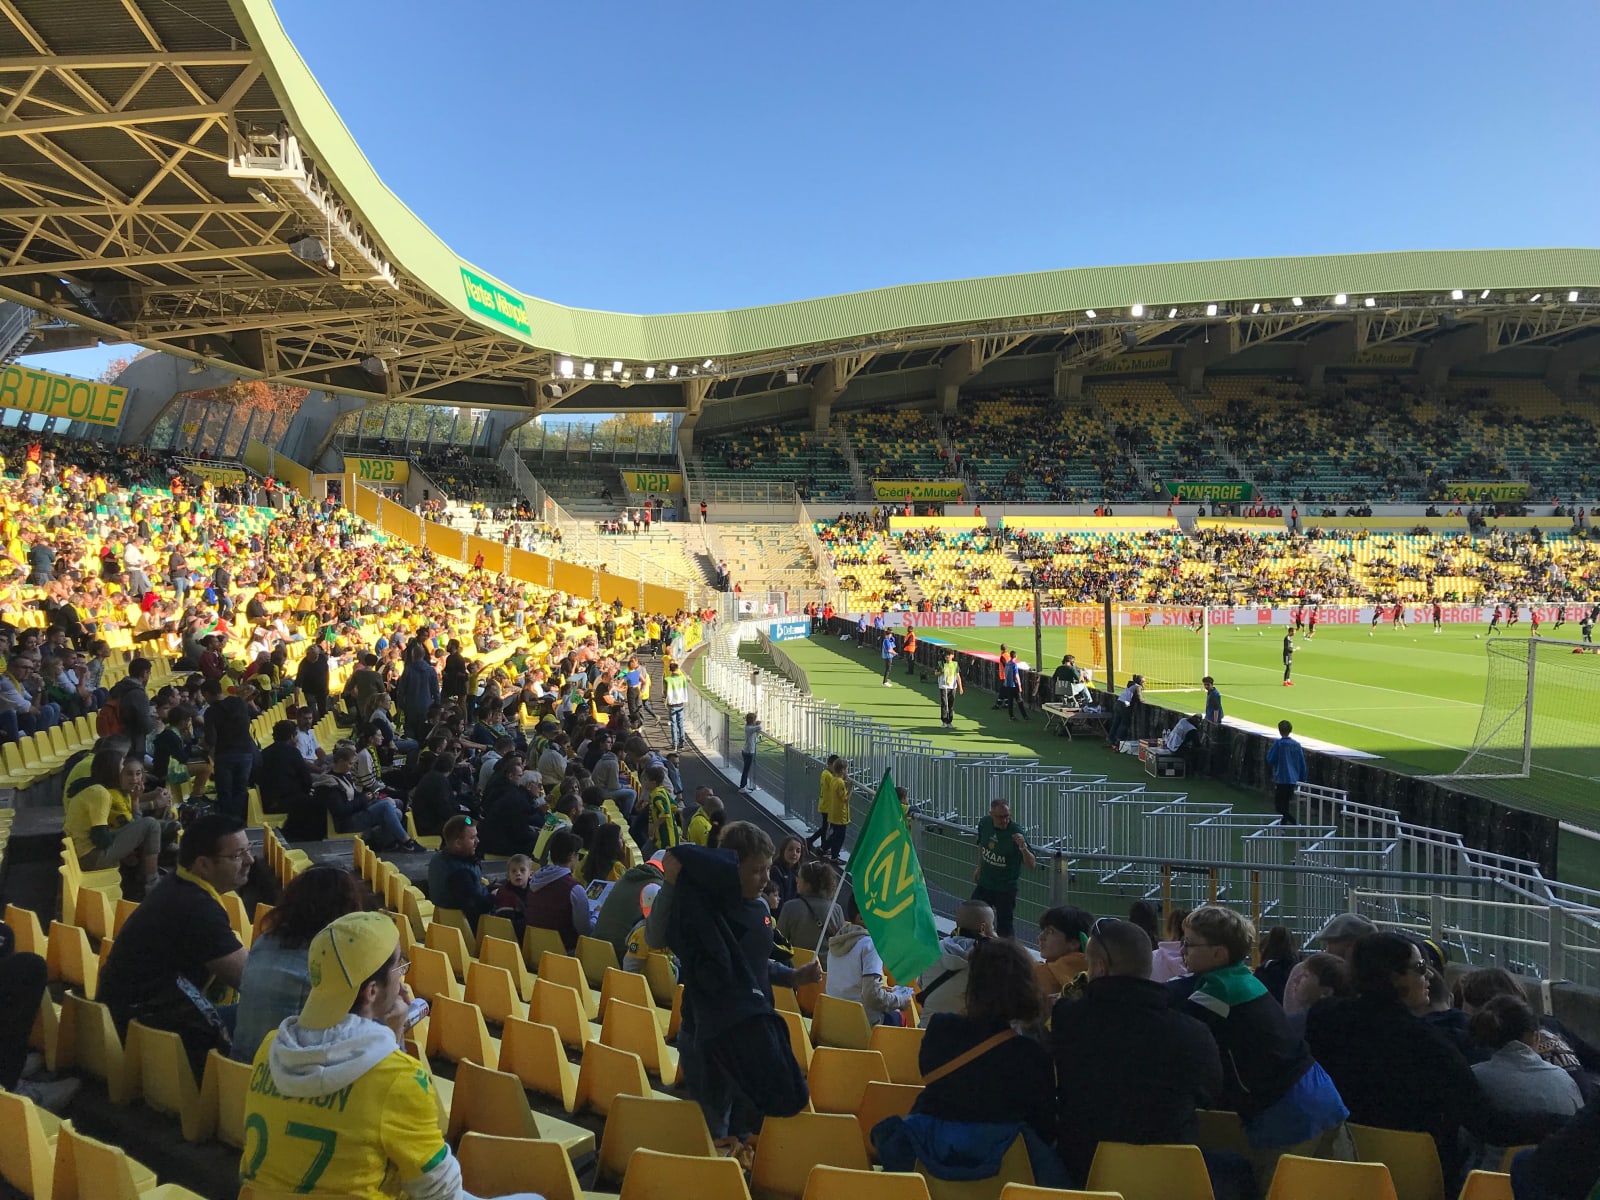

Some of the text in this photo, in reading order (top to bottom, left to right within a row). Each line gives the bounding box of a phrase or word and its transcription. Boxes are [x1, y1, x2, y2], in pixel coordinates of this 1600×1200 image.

[360, 460, 395, 480] N2G
[637, 473, 669, 492] N2H
[924, 486, 960, 497] Mutuel
[1177, 485, 1242, 499] SYNERGIE
[1466, 486, 1526, 499] NANTES
[902, 612, 976, 627] SYNERGIE
[1414, 608, 1483, 623] SYERGIE
